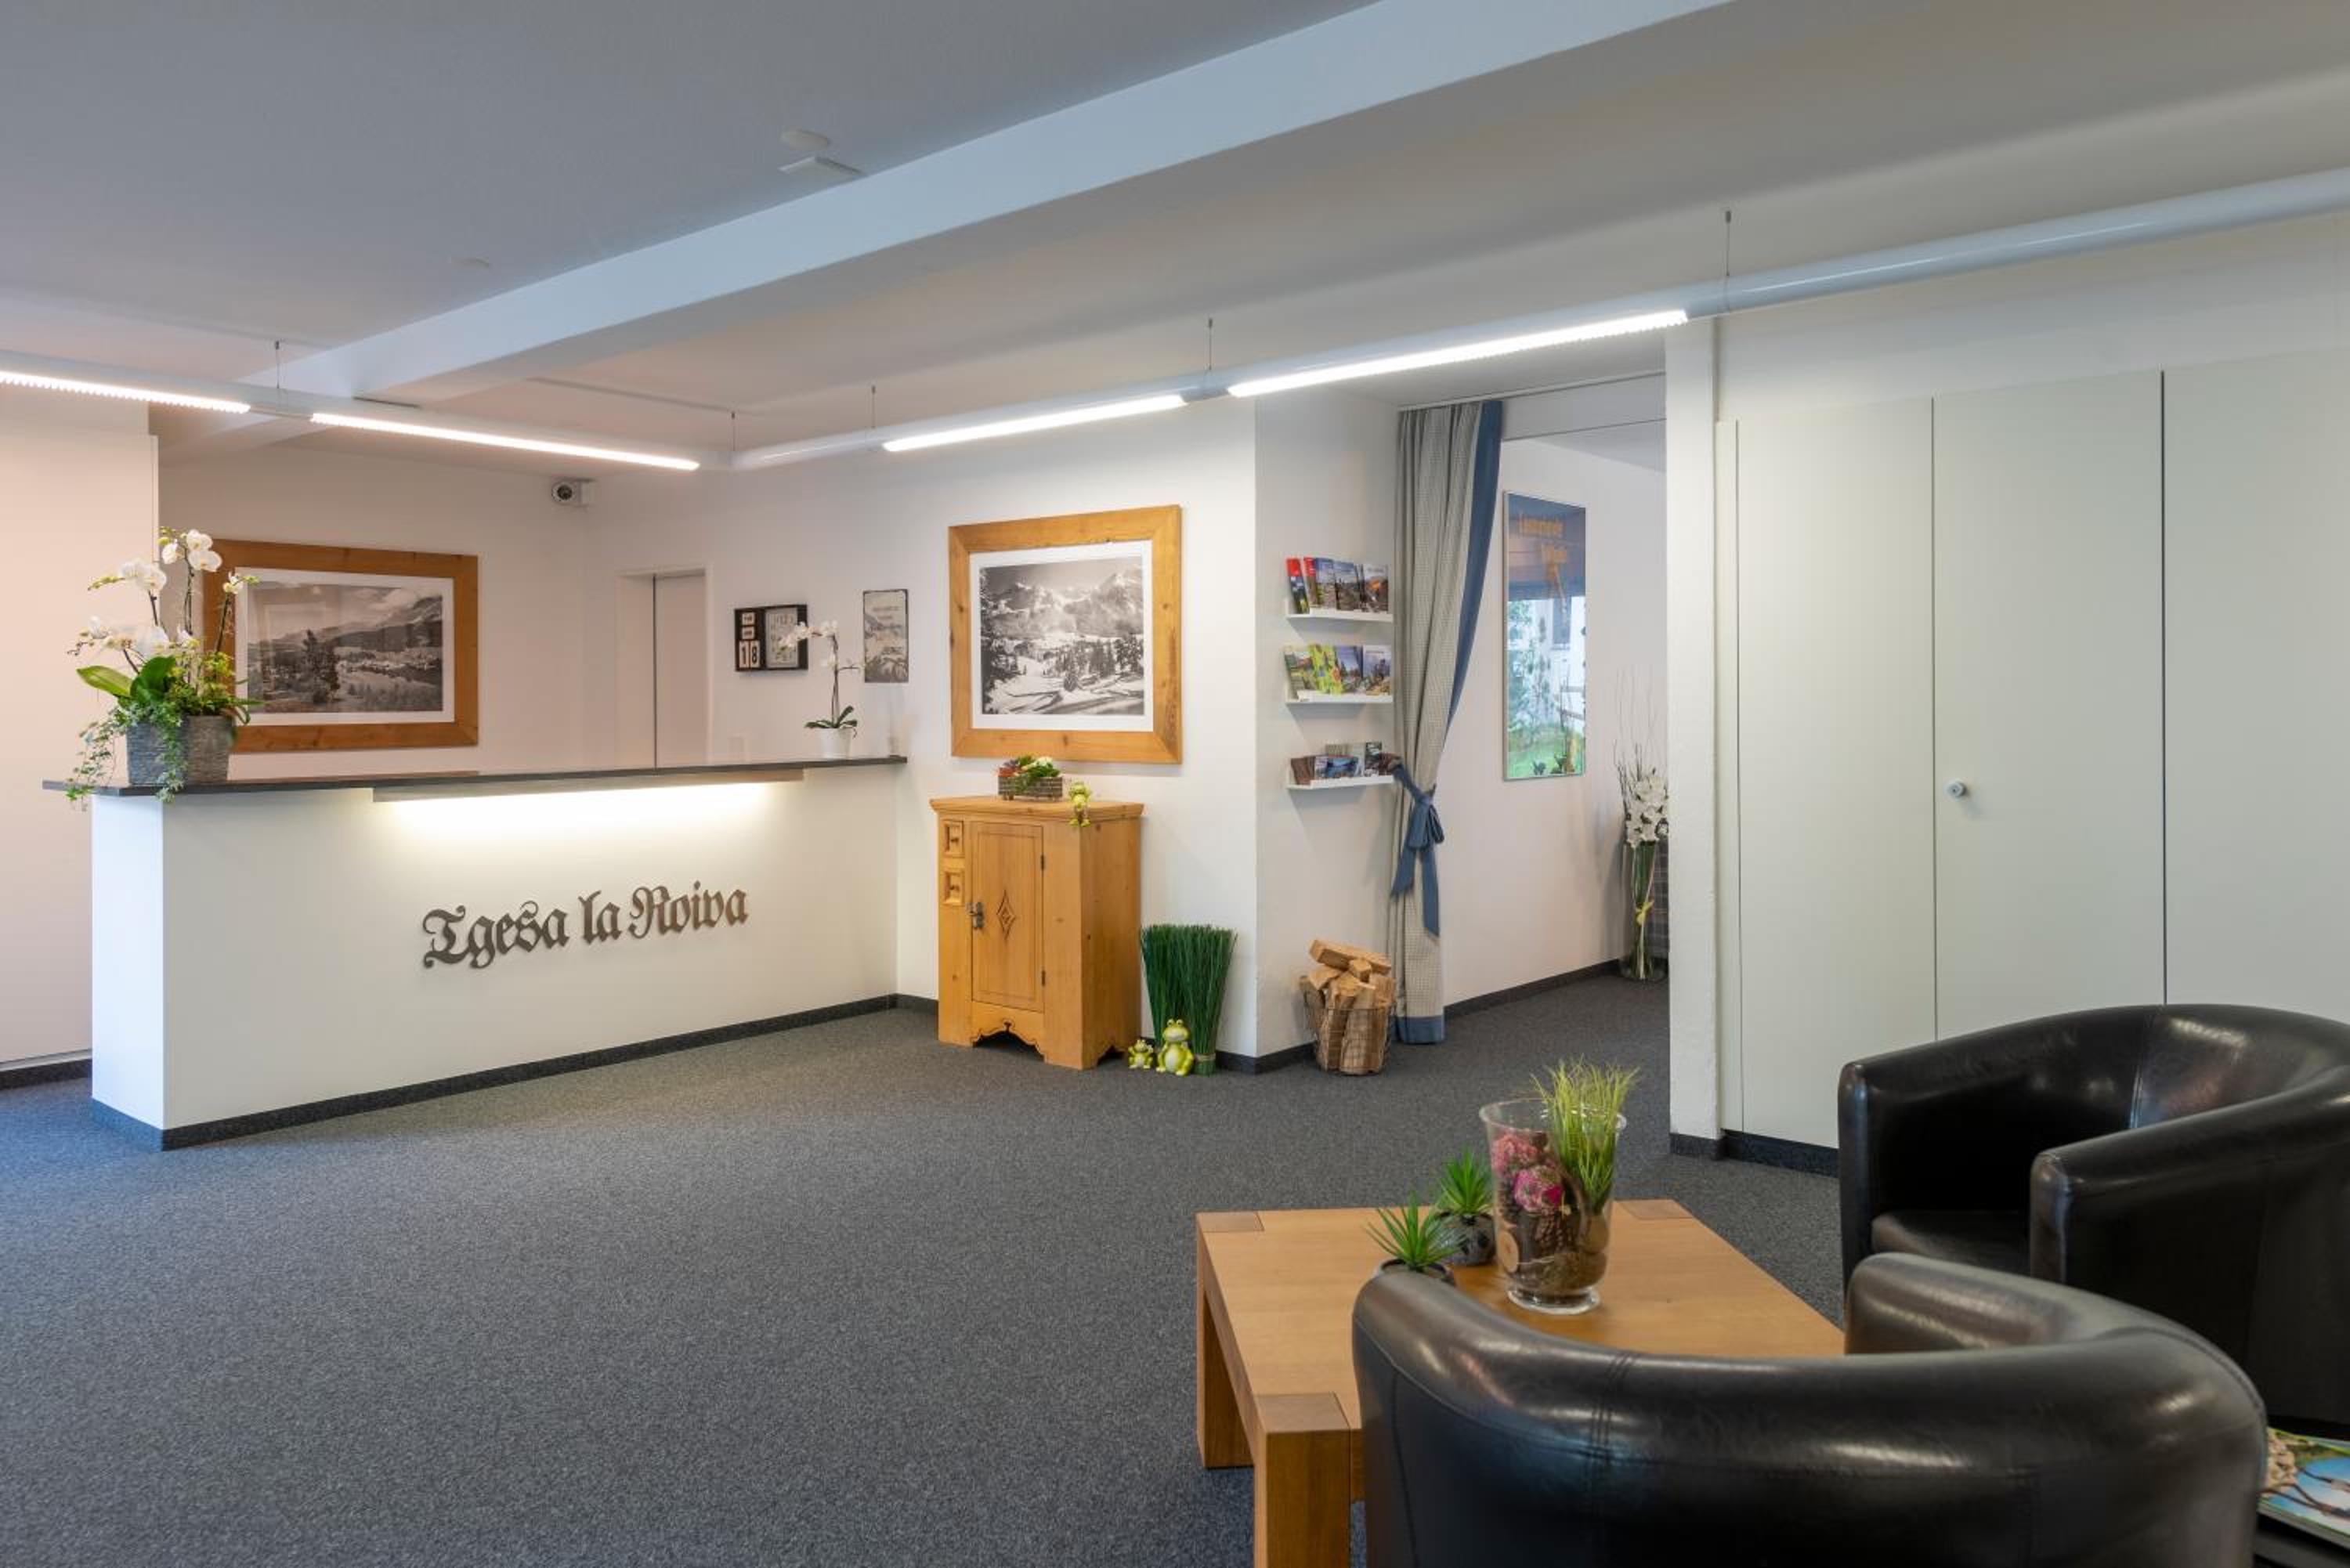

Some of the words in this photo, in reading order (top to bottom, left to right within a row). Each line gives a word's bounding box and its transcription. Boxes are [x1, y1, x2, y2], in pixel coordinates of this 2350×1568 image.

[741, 645, 757, 665] 18
[422, 900, 570, 969] Tgesa
[577, 890, 622, 945] la
[627, 880, 749, 939] Roiva
